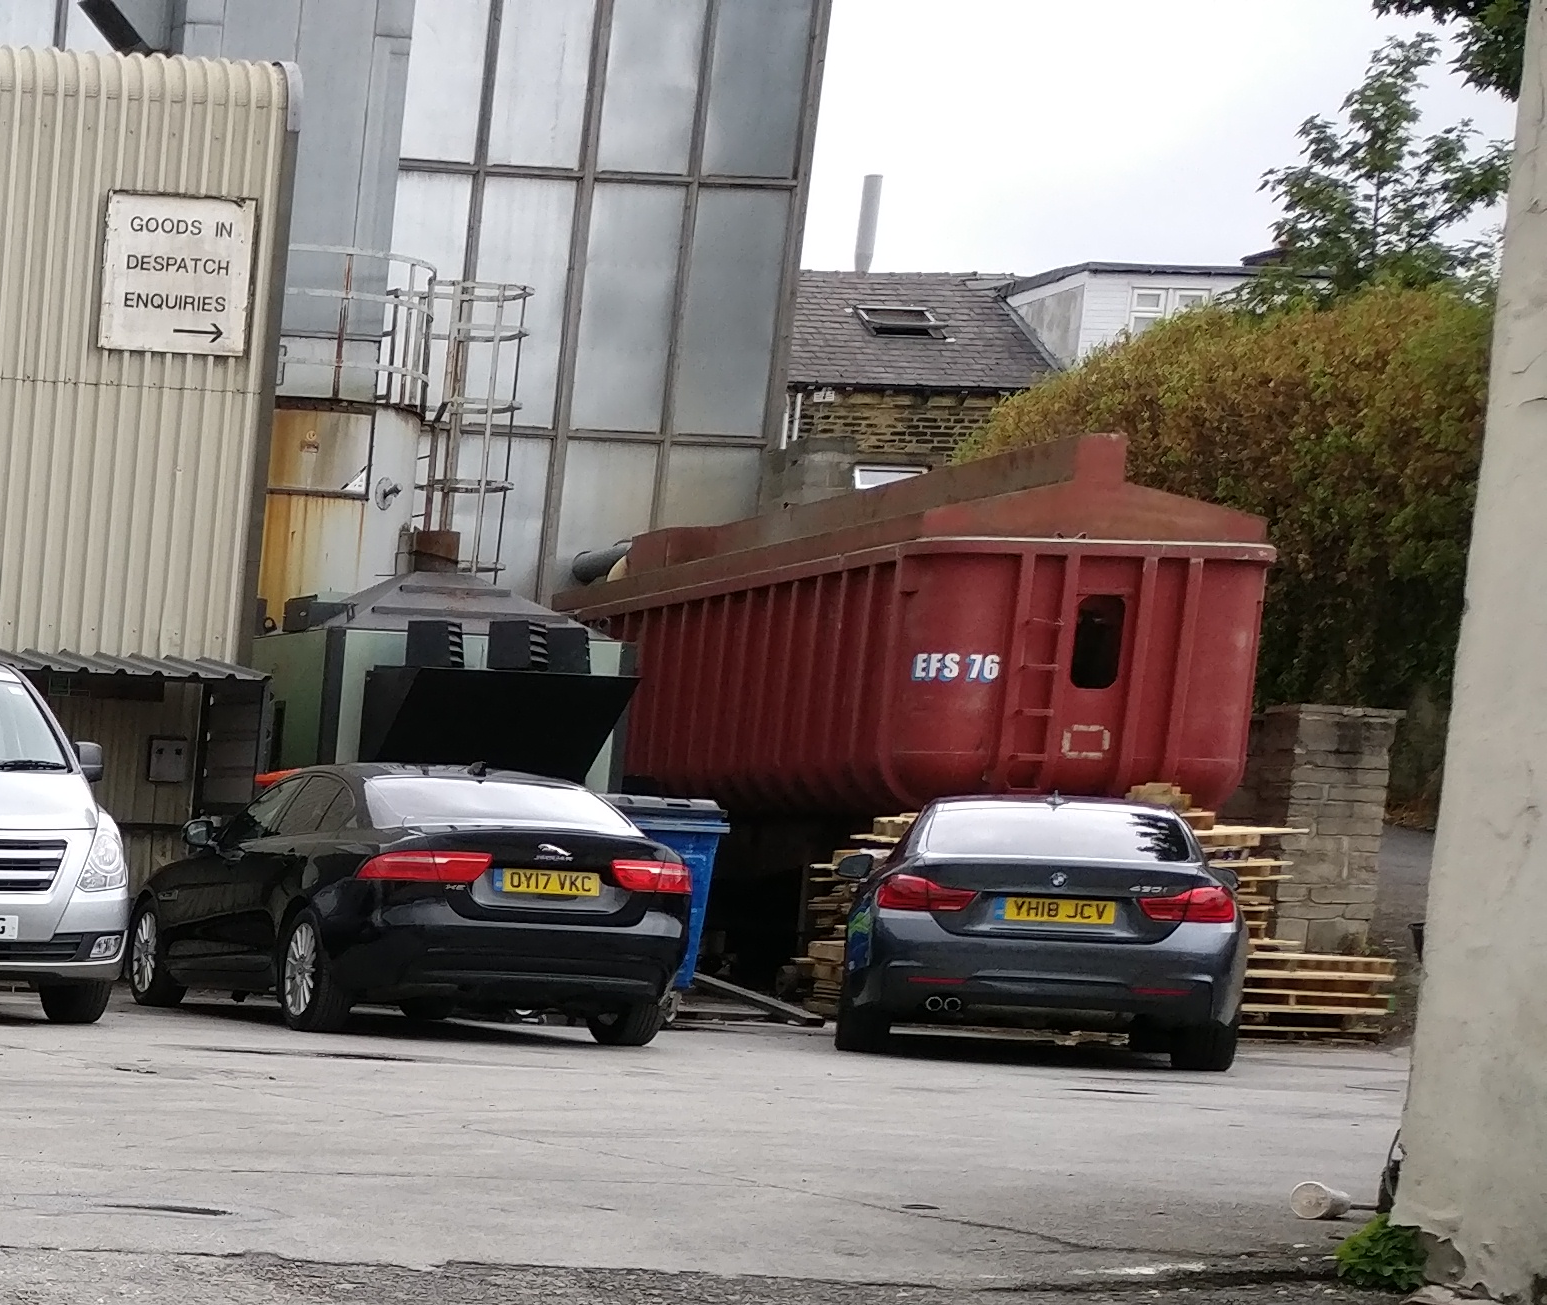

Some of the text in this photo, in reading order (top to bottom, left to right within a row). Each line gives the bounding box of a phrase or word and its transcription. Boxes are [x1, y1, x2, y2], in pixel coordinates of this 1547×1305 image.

[130, 215, 233, 238] GOODS IN
[126, 254, 230, 276] DESPATCH
[123, 291, 227, 313] ENQUIRIES
[913, 652, 1000, 680] EFS 76
[509, 871, 592, 892] OY17 VKC
[1013, 900, 1107, 920] YH18 JCV
